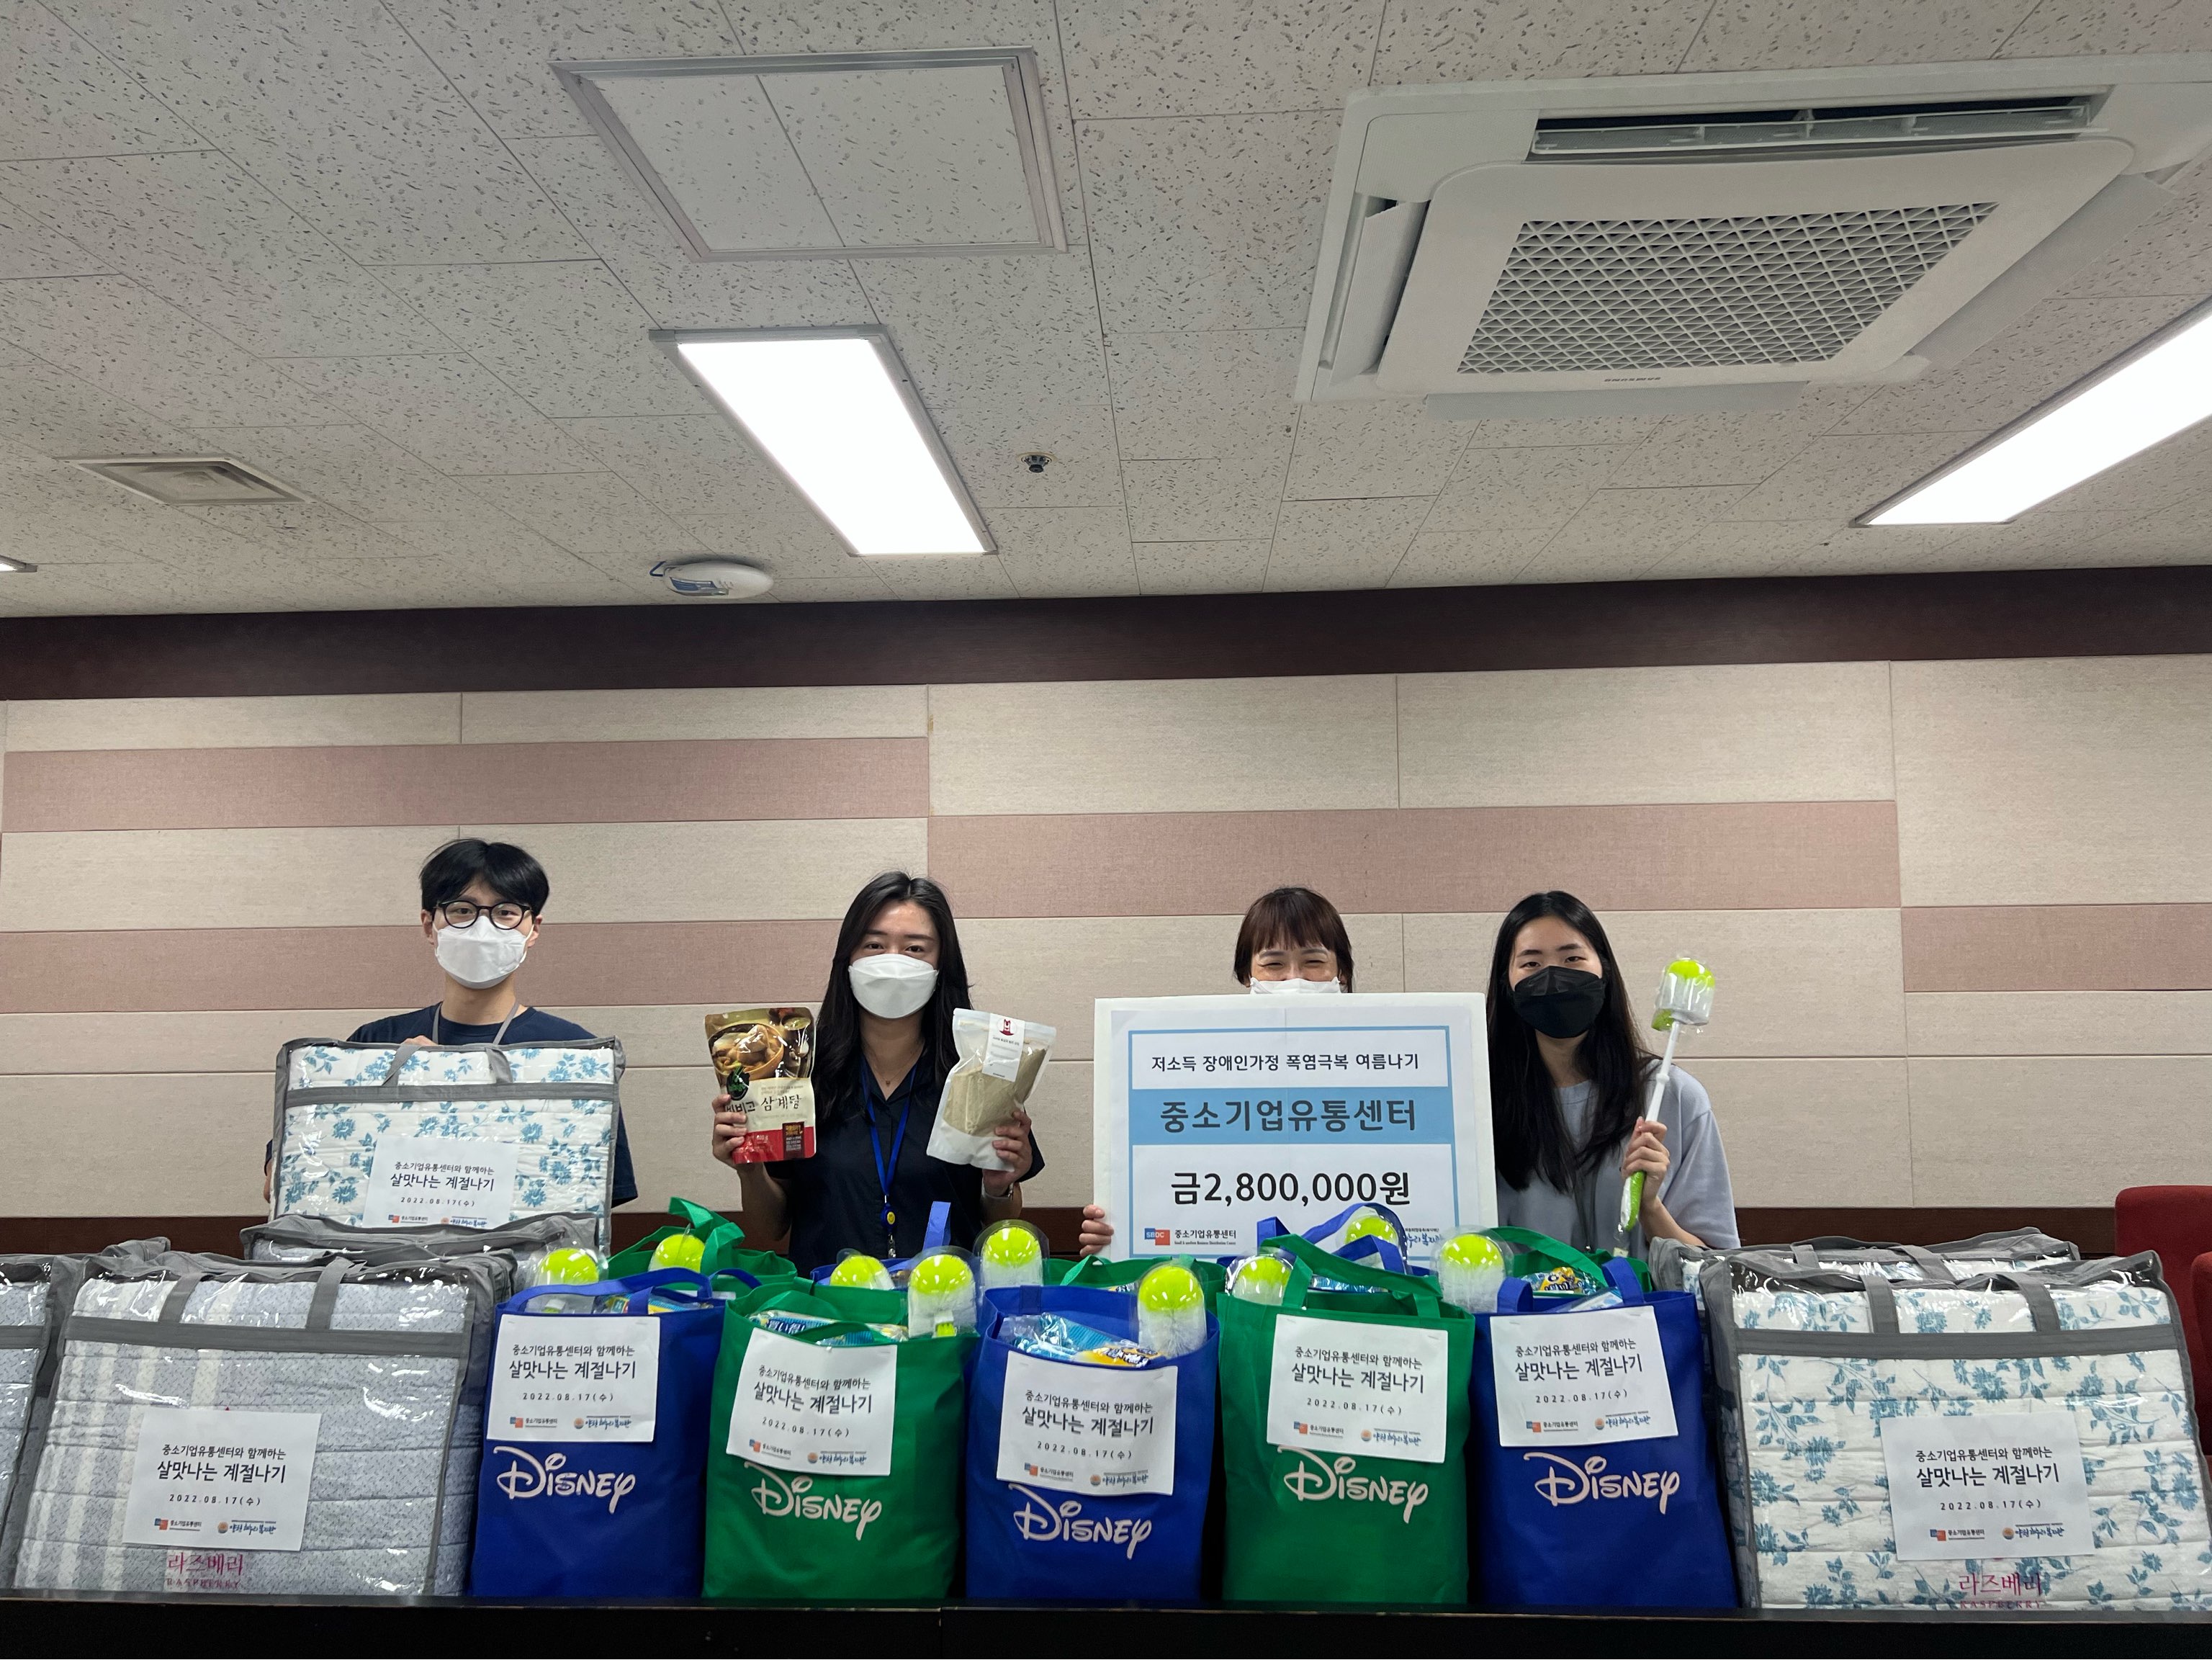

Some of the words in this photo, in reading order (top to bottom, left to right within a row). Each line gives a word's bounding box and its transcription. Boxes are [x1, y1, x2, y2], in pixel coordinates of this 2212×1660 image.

[1151, 1055, 1197, 1072] 저소득
[1202, 1054, 1279, 1072] 장애인가정
[1285, 1054, 1349, 1070] 폭염극복
[1356, 1053, 1419, 1070] 여름나기
[1160, 1099, 1416, 1133] 중소기업유통센터
[395, 1161, 462, 1172] 중소기업유통센터와
[464, 1166, 495, 1175] 함께하는
[390, 1173, 441, 1189] 살맛나는
[446, 1176, 495, 1191] 계절나기
[1171, 1171, 1411, 1206] 금2,800,000원
[1174, 1229, 1236, 1239] 중소기업유통센터
[513, 1344, 593, 1357] 중소기업유통센터와
[597, 1345, 635, 1357] 함께하는
[1295, 1346, 1379, 1366] 중소기업유통센터와
[1382, 1355, 1423, 1370] 함께하는
[1515, 1342, 1599, 1358] 중소기업유통센터와
[1601, 1338, 1636, 1352] 함께하는
[509, 1360, 568, 1380] 살맛나는
[575, 1361, 636, 1380] 계절나기
[759, 1365, 830, 1391] 중소기업유통센터와
[833, 1378, 871, 1391] 함께하는
[1292, 1363, 1354, 1388] 살맛나는
[1361, 1370, 1424, 1394] 계절나기
[1515, 1359, 1580, 1381] 살맛나는
[1586, 1353, 1642, 1377] 계절나기
[754, 1381, 804, 1412] 살맛나는
[809, 1394, 872, 1414] 계절나기
[1025, 1390, 1110, 1414] 중소기업유통센터와
[1113, 1402, 1153, 1414] 함께하는
[1022, 1406, 1084, 1435] 살맛나는
[1091, 1416, 1154, 1438] 계절나기
[162, 1444, 244, 1458] 중소기업유통센터와
[248, 1448, 287, 1461] 함께하는
[1915, 1449, 2008, 1463] 중소기업유통센터와
[2012, 1446, 2053, 1460] 함께하는
[157, 1461, 217, 1481] 살맛나는
[223, 1463, 286, 1484] 계절나기
[1917, 1466, 1987, 1488] 살맛나는
[1992, 1463, 2059, 1484] 계절나기
[168, 1552, 243, 1576] 라즈베리
[1959, 1572, 2041, 1597] 라즈베리
